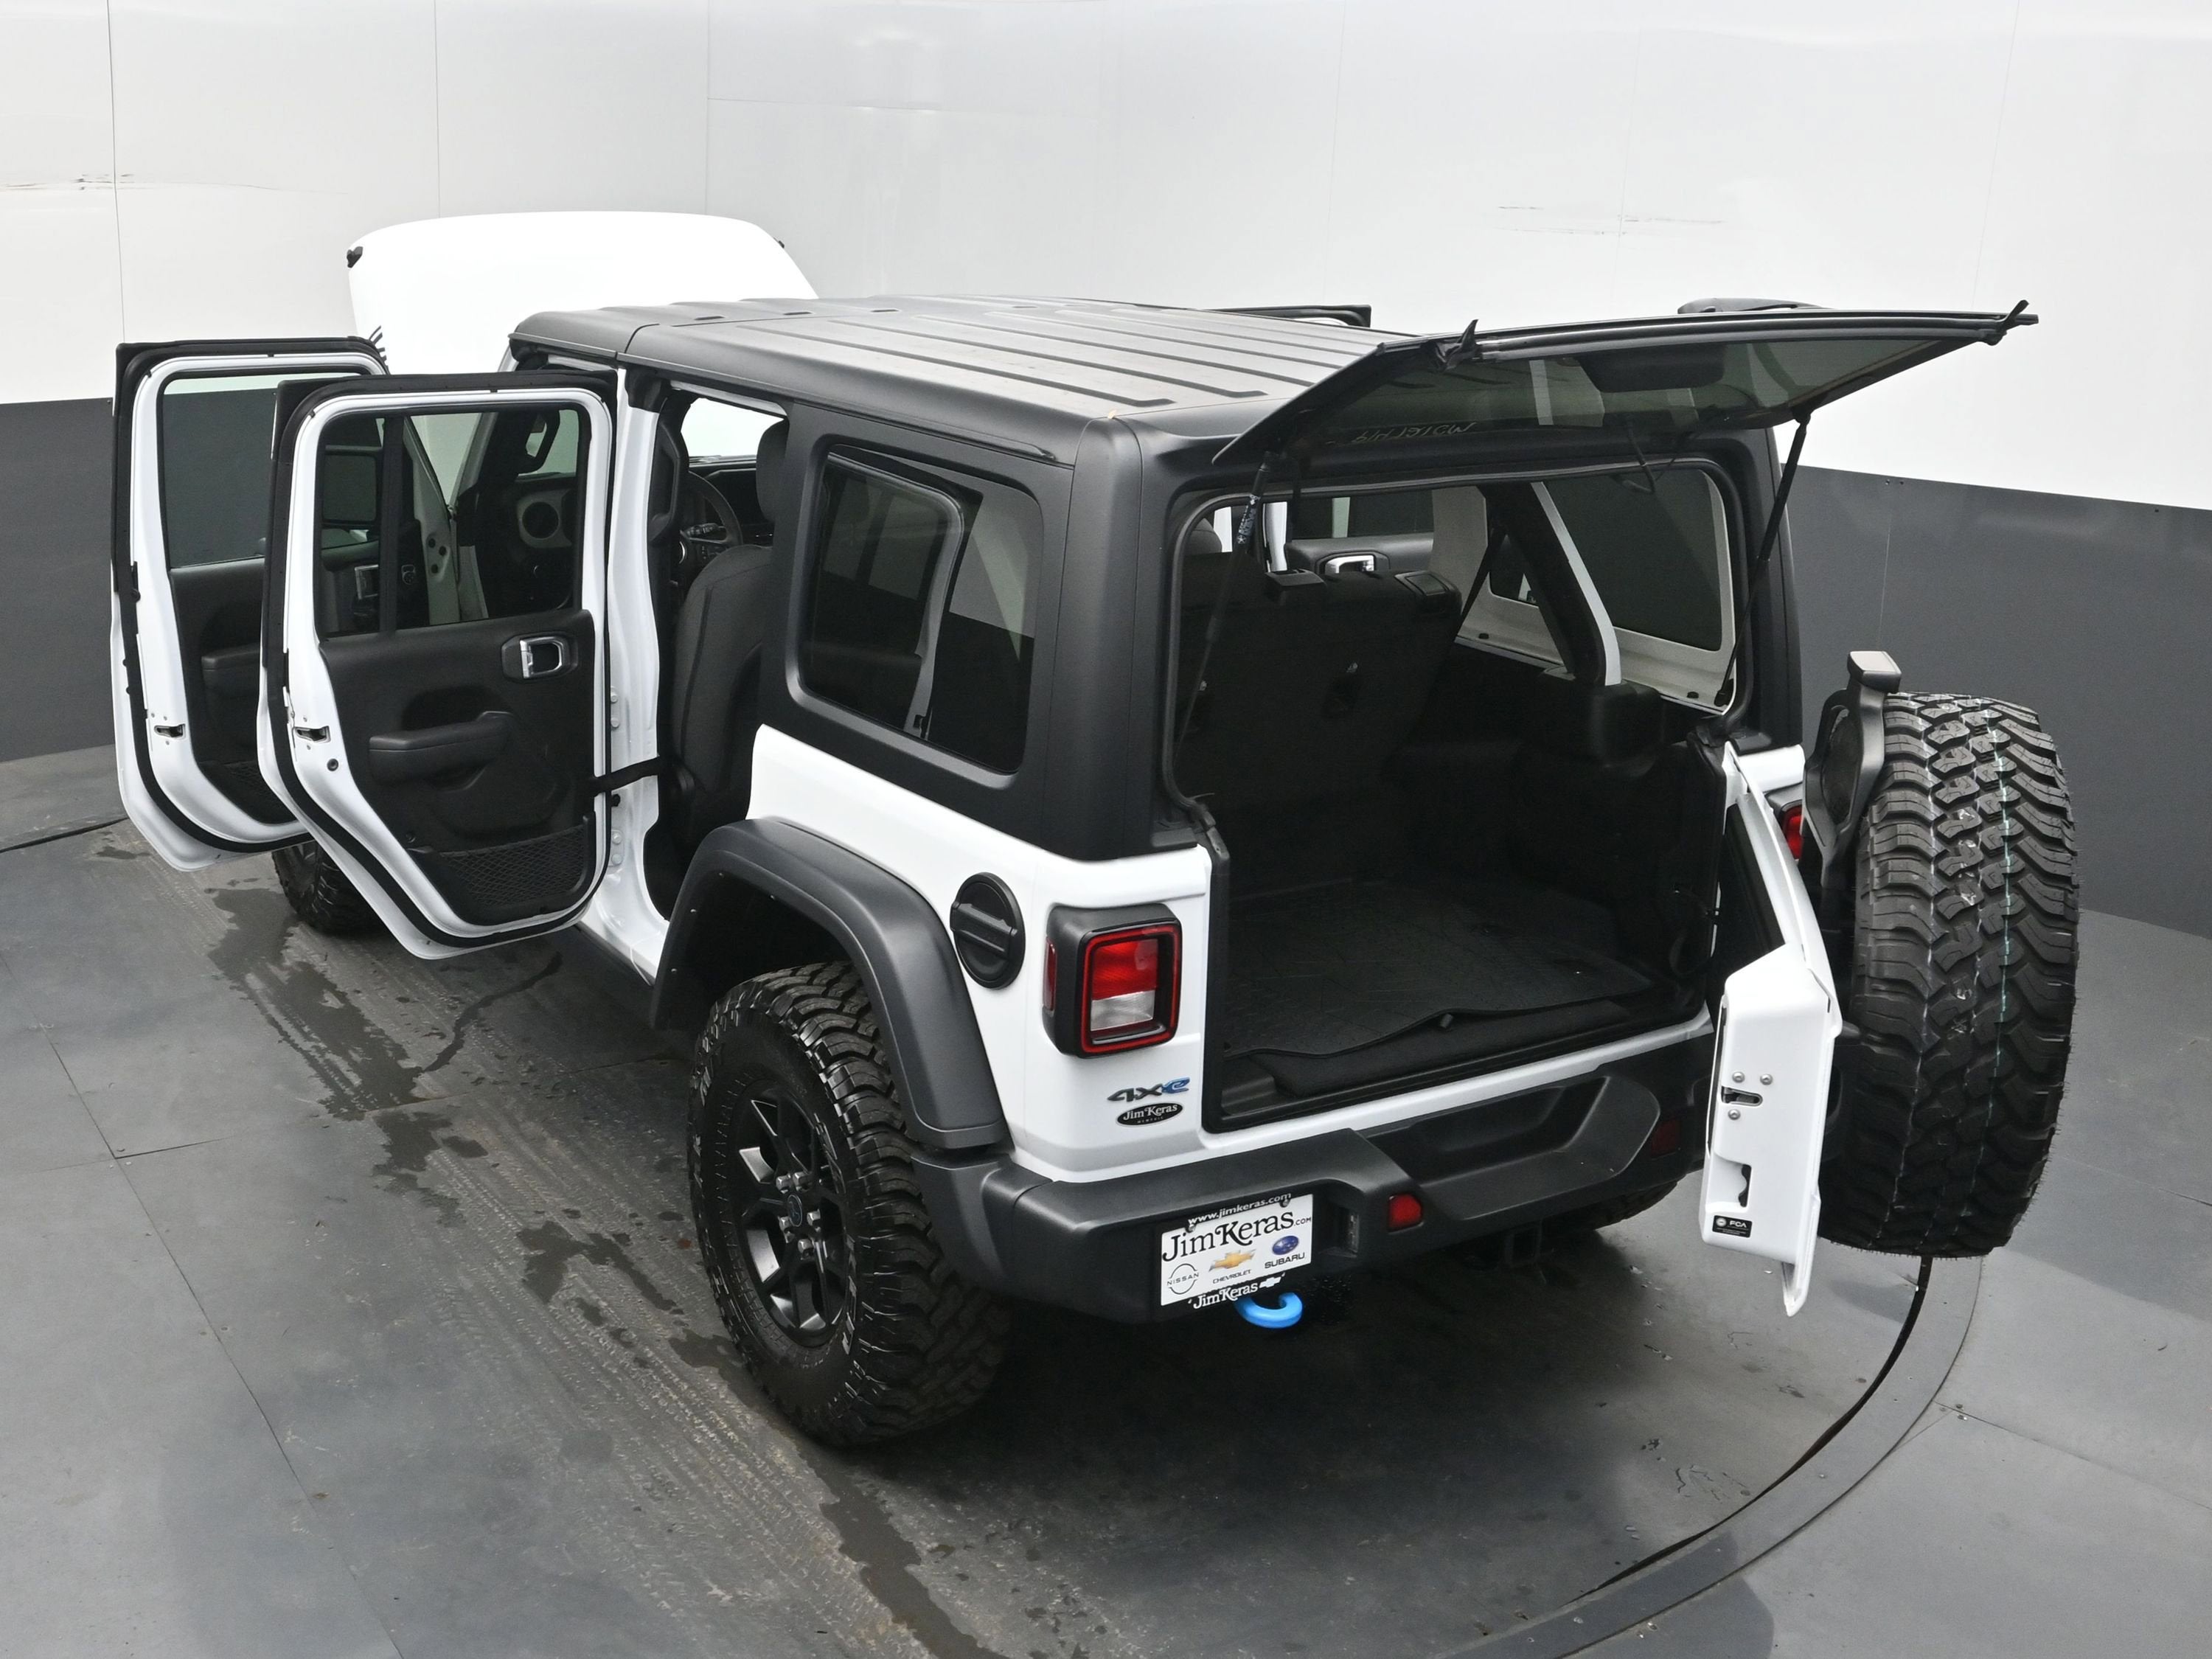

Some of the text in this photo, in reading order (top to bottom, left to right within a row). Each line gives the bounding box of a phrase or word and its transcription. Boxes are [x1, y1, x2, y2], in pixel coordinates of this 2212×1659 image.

[1188, 1193, 1292, 1225] www.jimkeras.com
[1265, 1252, 1306, 1269] SUBARU
[1166, 1272, 1200, 1286] NISSAN
[1213, 1269, 1252, 1284] CHEVROLET
